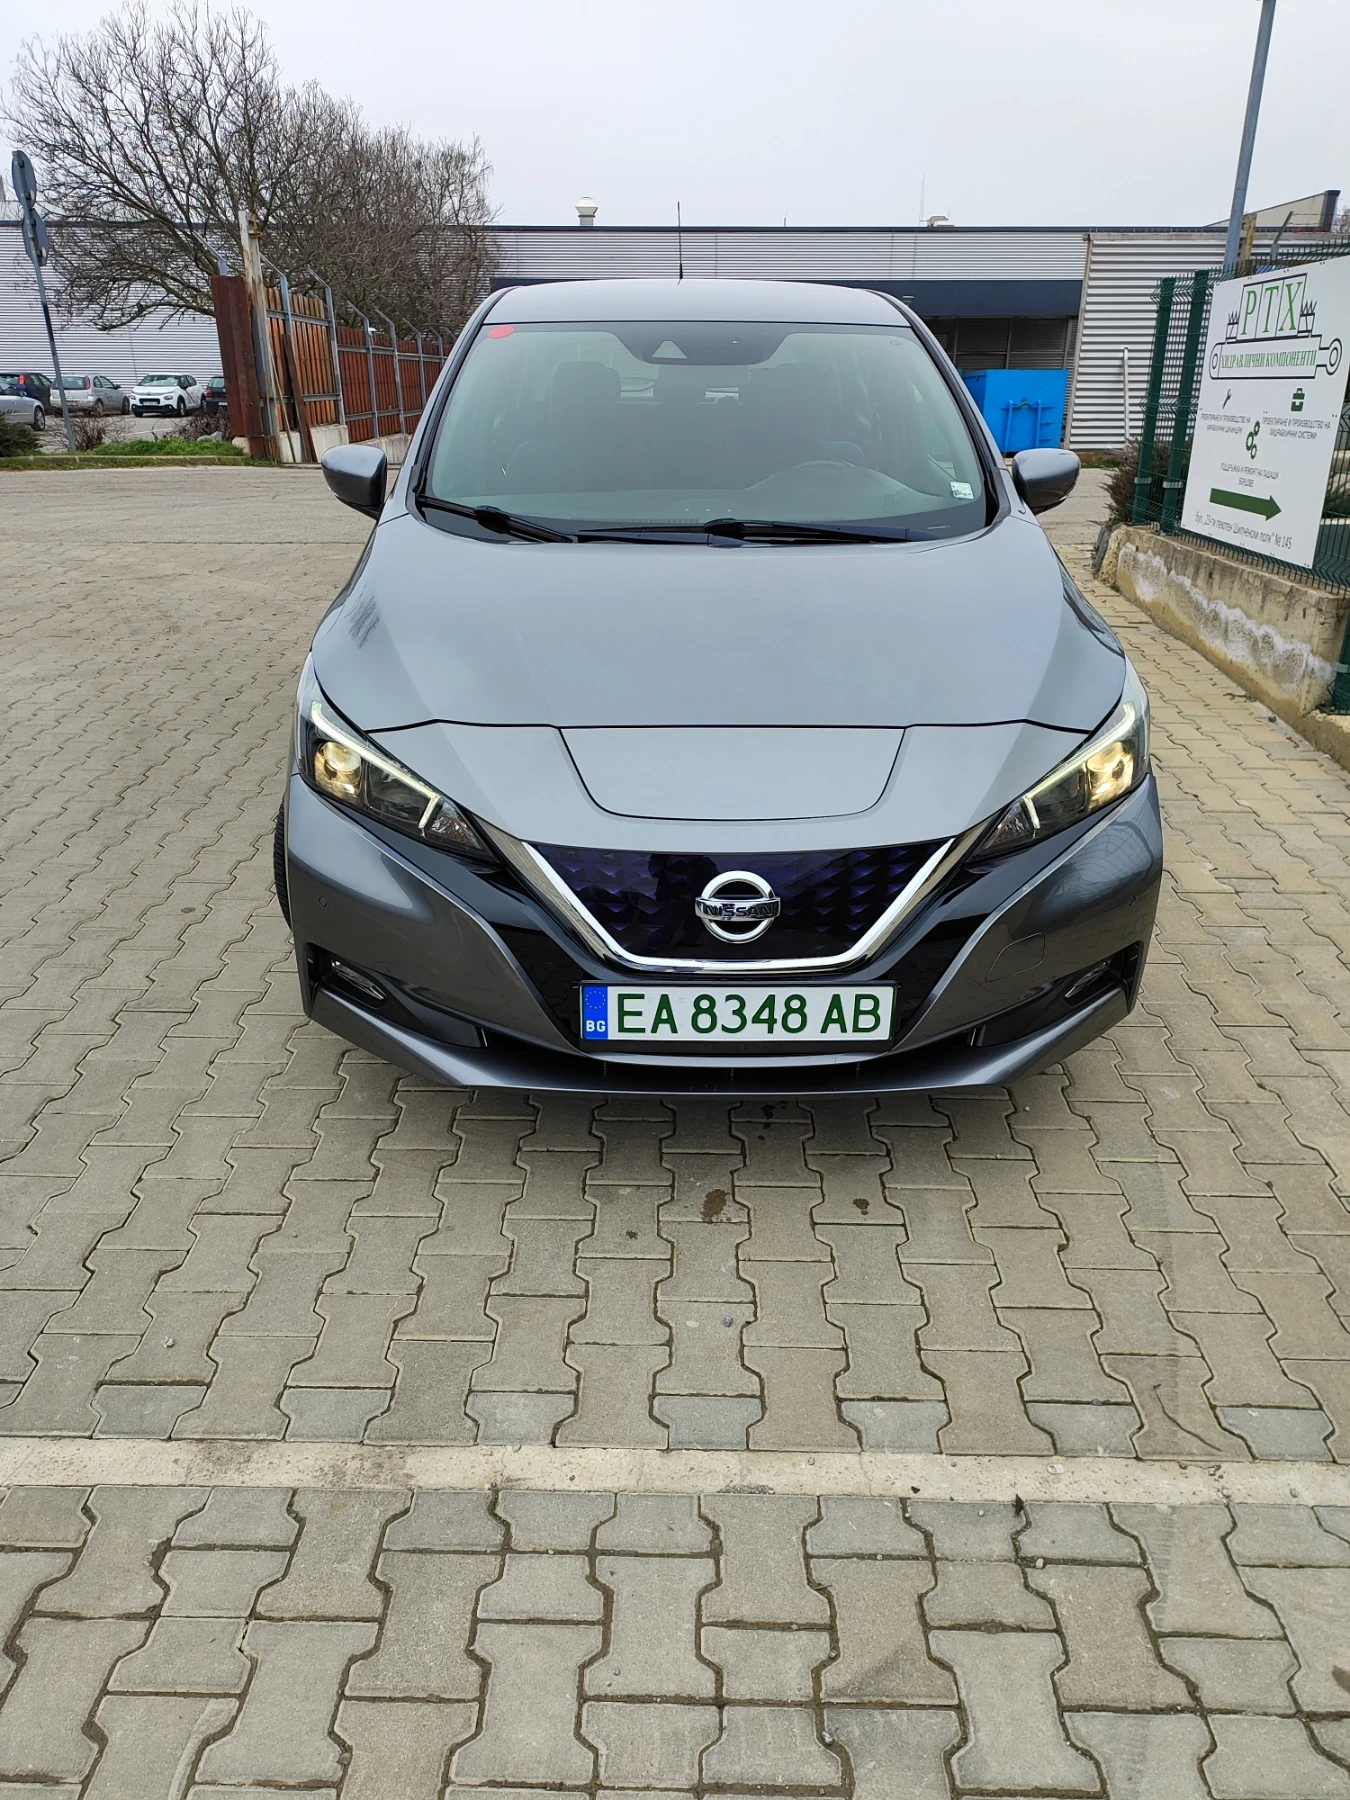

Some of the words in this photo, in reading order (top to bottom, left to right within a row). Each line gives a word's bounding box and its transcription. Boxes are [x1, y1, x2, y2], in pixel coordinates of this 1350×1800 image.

[1220, 353, 1266, 369] ХИДРАВЛИЧНИ
[1265, 350, 1317, 367] КОМПОНЕНТИ
[1281, 535, 1292, 550] 145
[702, 902, 772, 918] NISSAN
[617, 993, 678, 1033] EA
[691, 993, 807, 1034] 8348
[820, 993, 881, 1033] AB
[586, 1020, 606, 1032] BG
